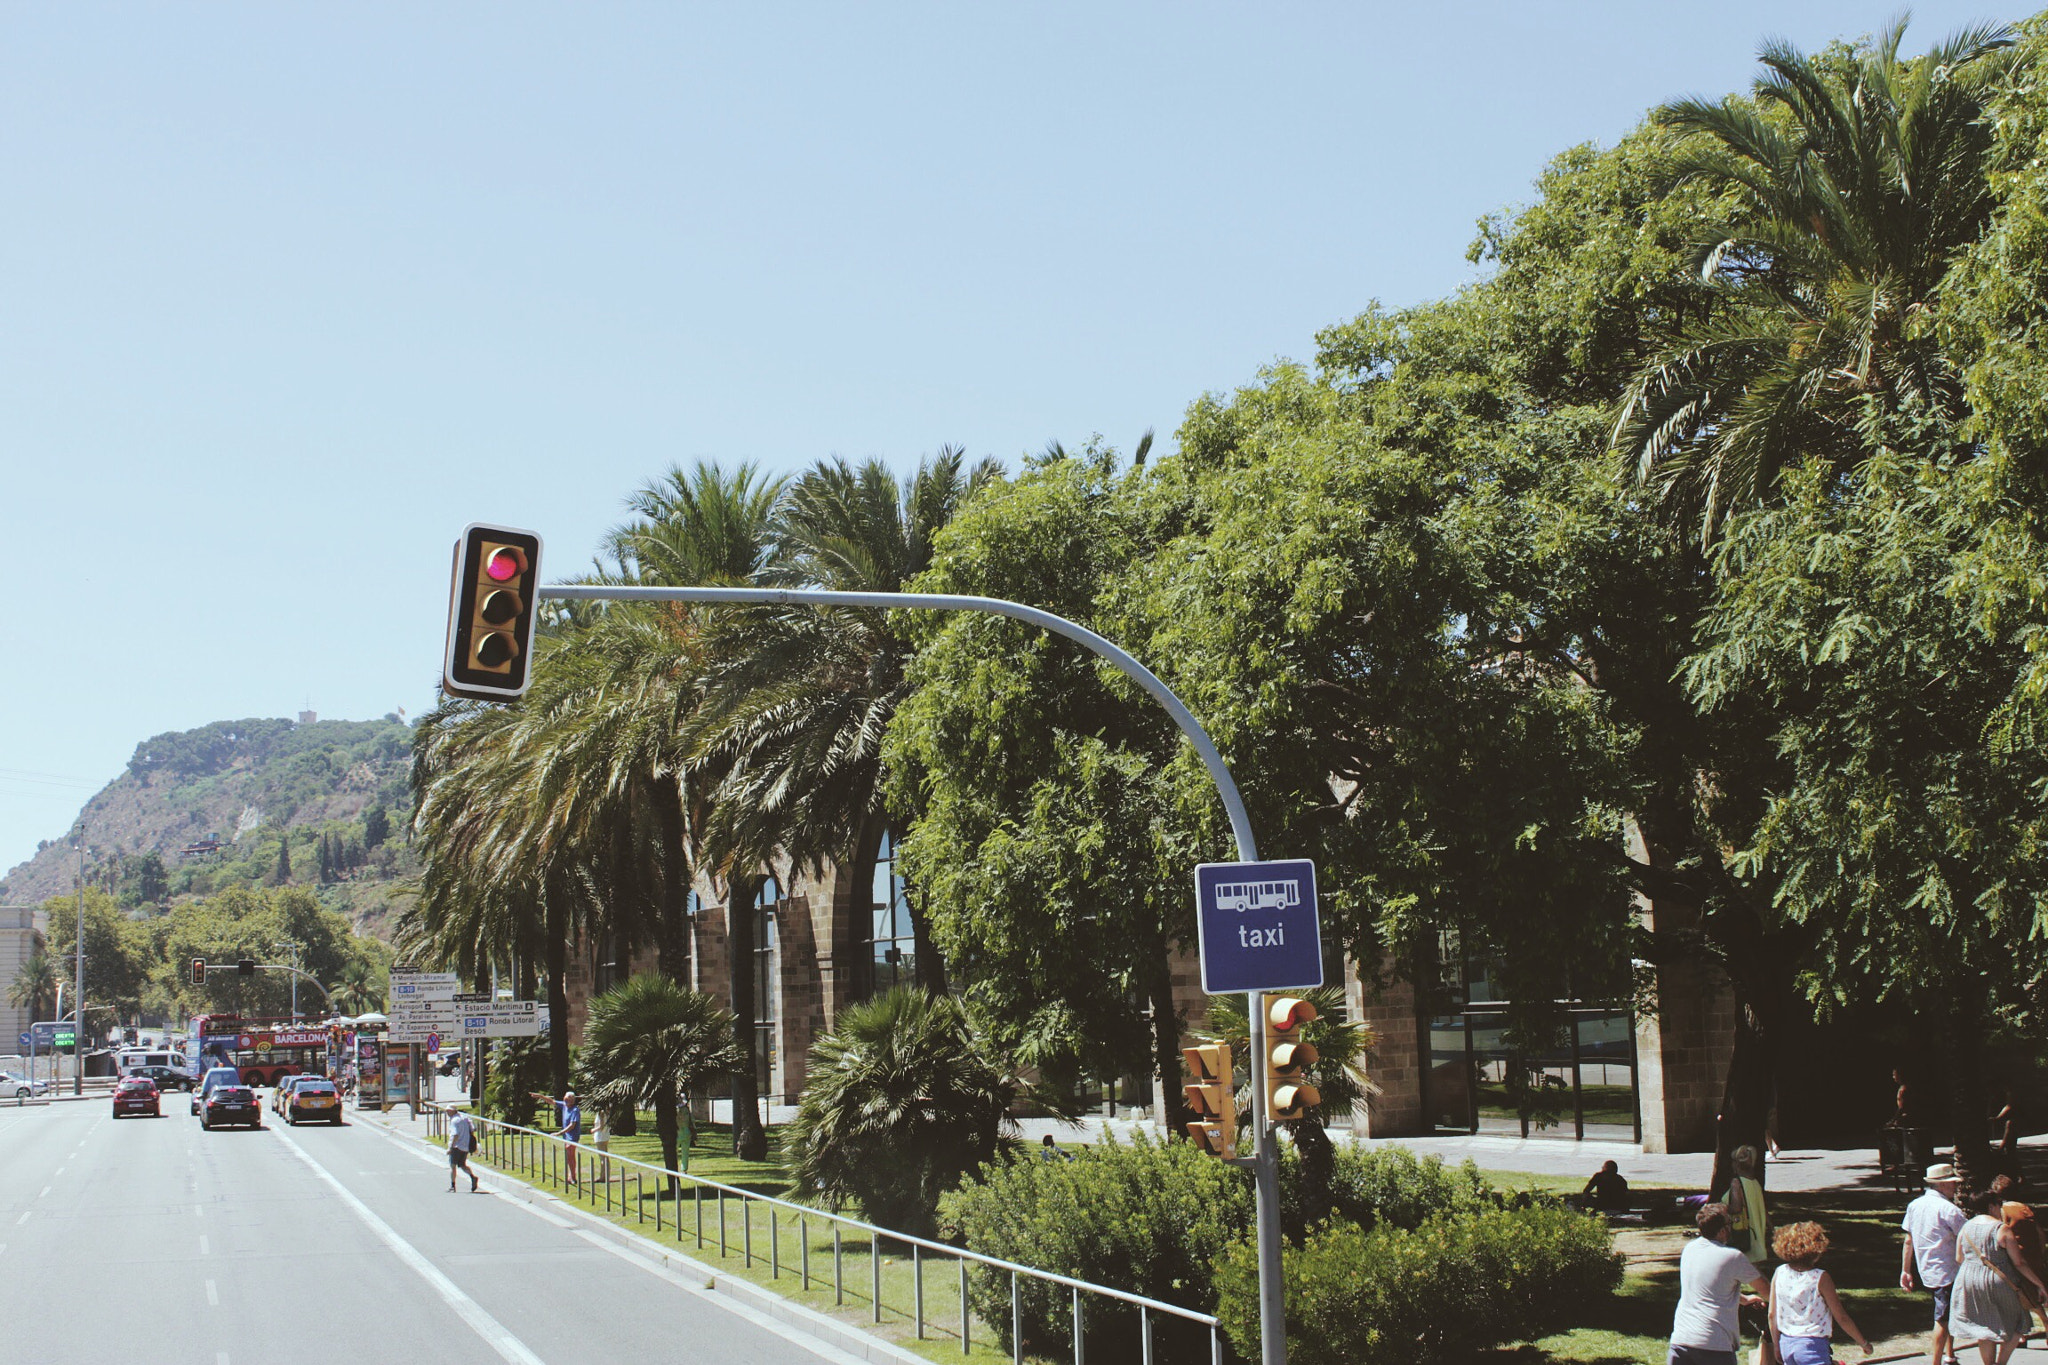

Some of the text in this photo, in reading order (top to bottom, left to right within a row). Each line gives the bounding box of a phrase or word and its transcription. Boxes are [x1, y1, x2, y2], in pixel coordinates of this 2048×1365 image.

[1239, 922, 1284, 948] taxi
[398, 1003, 423, 1011] Aeroport
[464, 1004, 490, 1012] Estació
[466, 1016, 535, 1027] B-10 Ronda Litoral
[274, 1033, 328, 1044] BARCELONA
